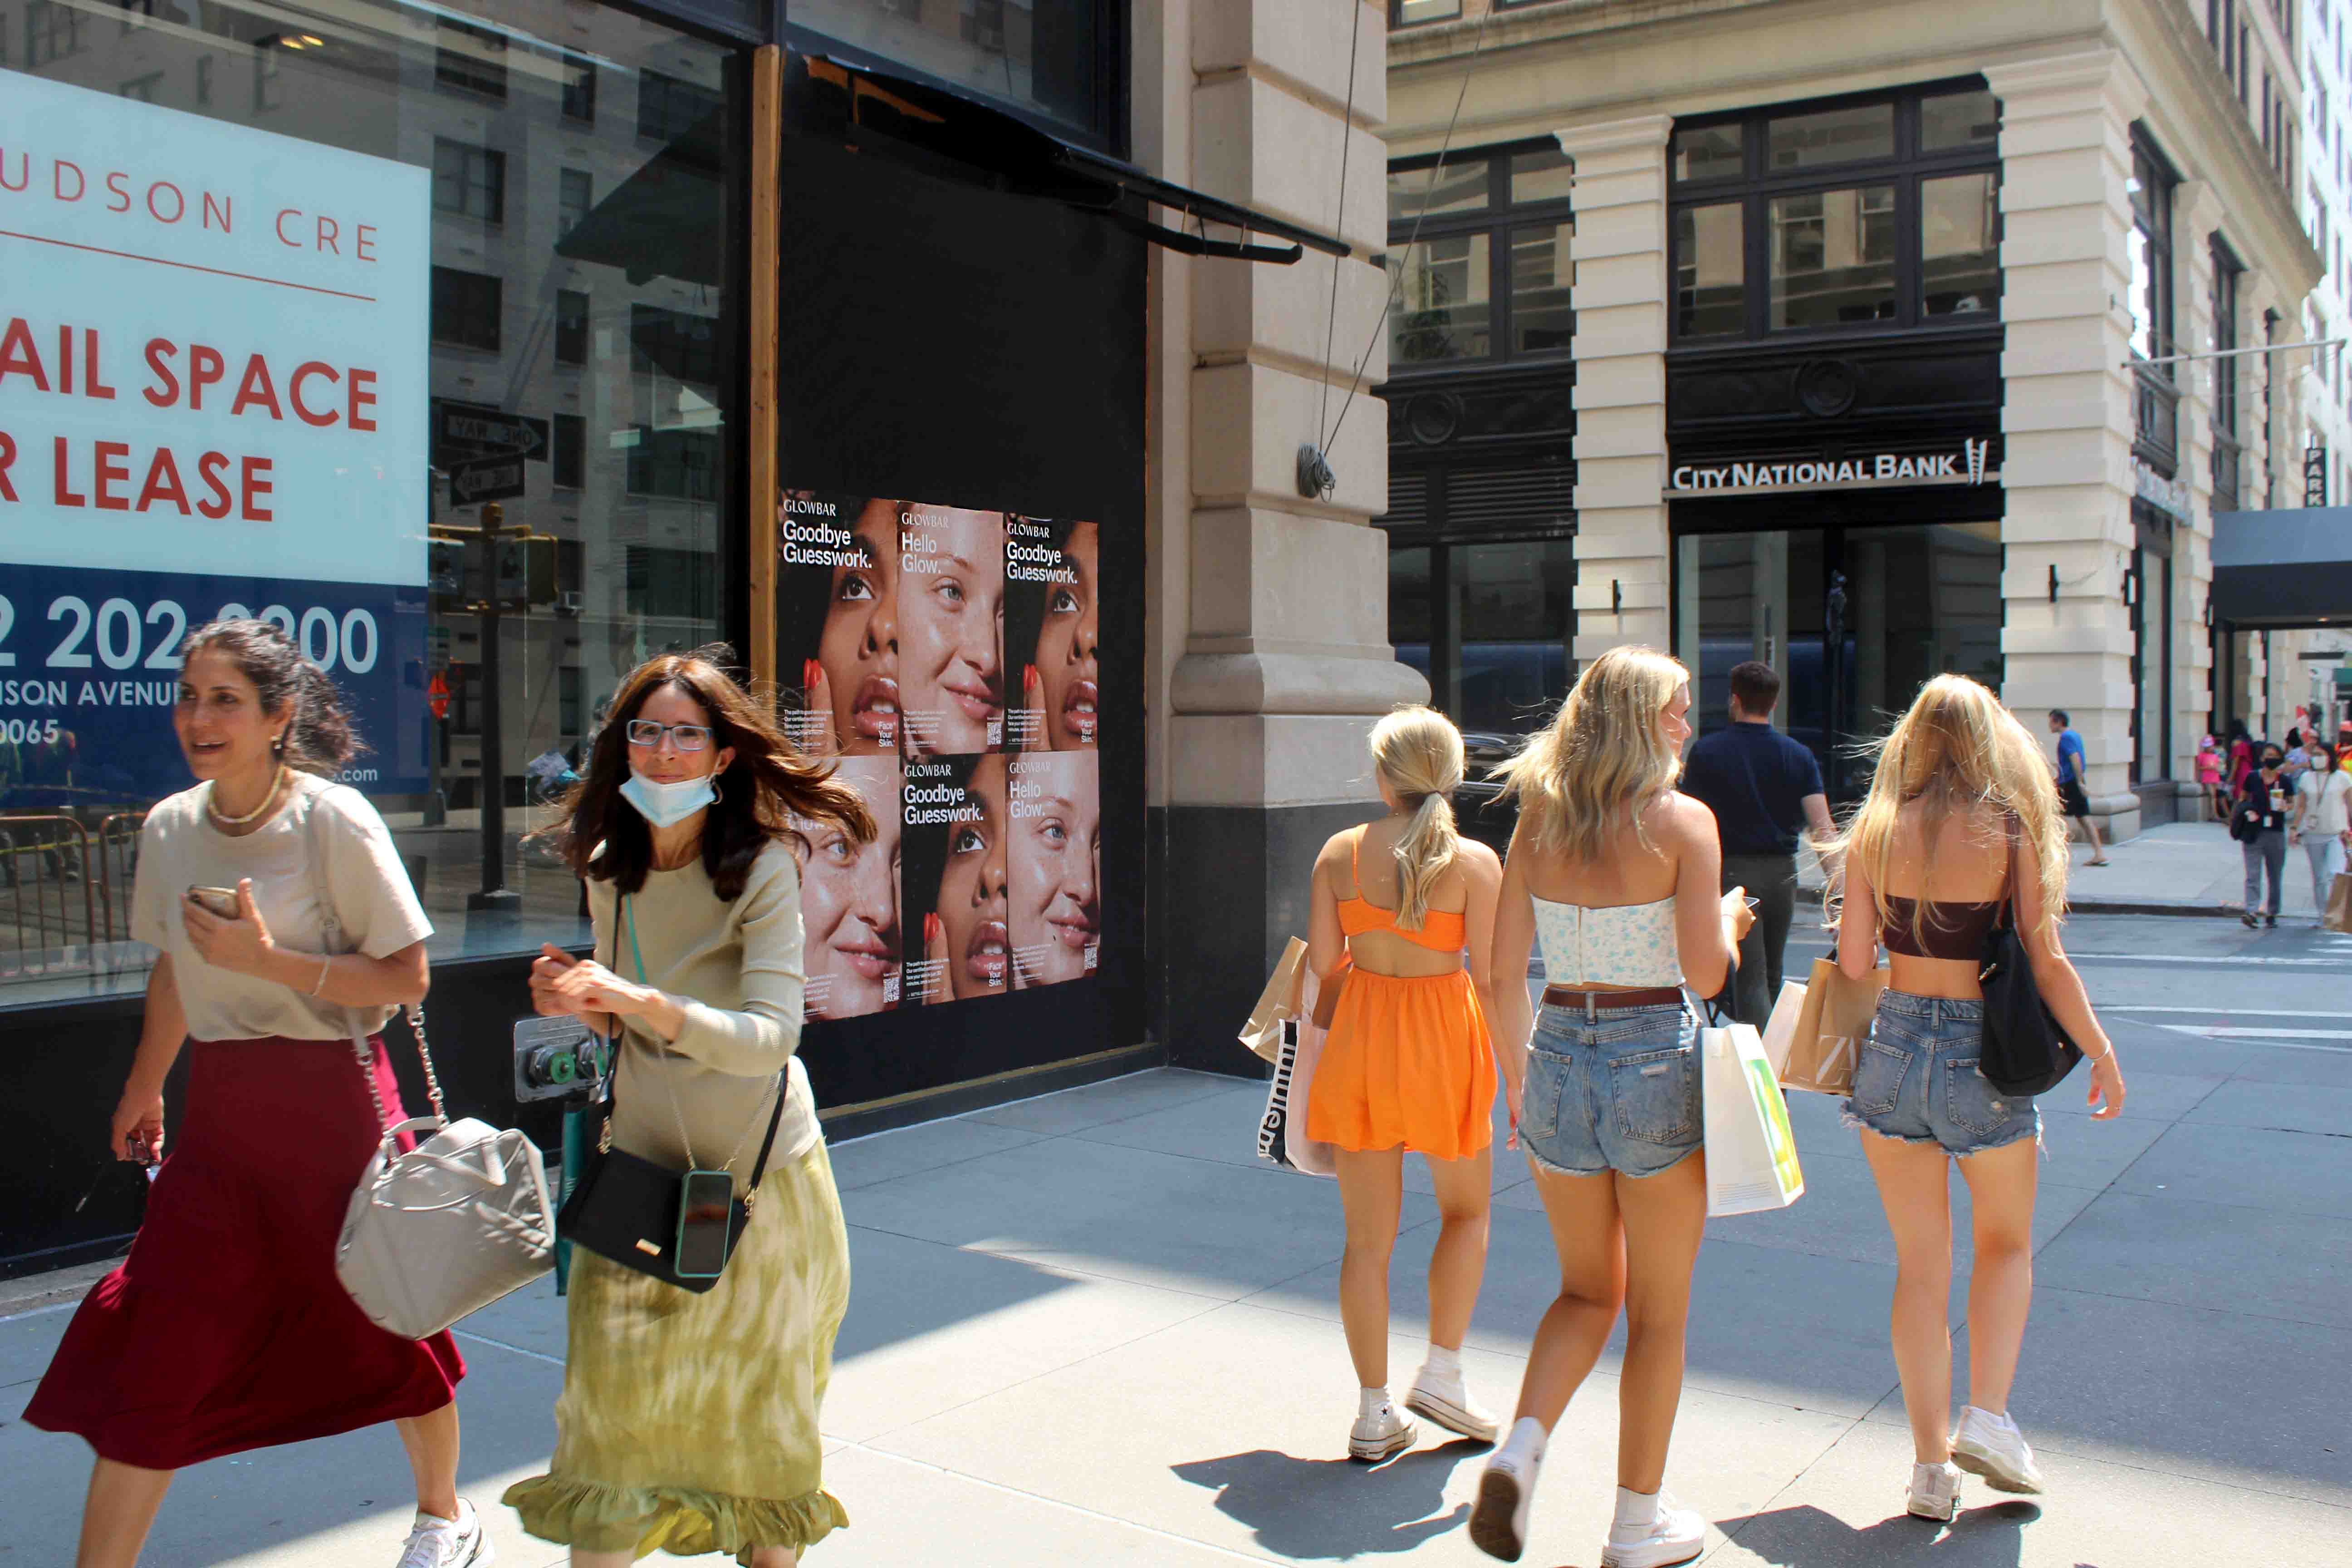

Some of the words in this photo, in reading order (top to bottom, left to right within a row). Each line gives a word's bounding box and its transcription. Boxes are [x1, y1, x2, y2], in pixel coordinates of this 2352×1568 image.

[276, 209, 377, 262] CRE
[0, 317, 115, 400] AIL
[142, 338, 376, 432] SPACE
[54, 436, 272, 522] LEASE
[1673, 466, 1729, 490] CITY
[1732, 460, 1871, 486] NATIONAL
[1874, 454, 1957, 480] BANK
[783, 500, 836, 516] GLOWBAR
[902, 512, 949, 528] GLOWBAR
[1007, 523, 1049, 538] GLOWBAR
[783, 520, 851, 548] Goodbye
[902, 532, 937, 553] Hello
[783, 543, 872, 568] Guesswork.
[902, 554, 941, 573] Glow.
[1007, 541, 1061, 566] Goodbye
[1007, 561, 1078, 584] Guesswork.
[46, 595, 186, 670] 202
[216, 603, 378, 674] 00
[904, 764, 951, 777] GLOWBAR
[904, 784, 965, 806] Goodbye
[1009, 781, 1042, 799] Hello
[904, 803, 984, 825] Guesswork.
[1010, 801, 1045, 818] Glow.
